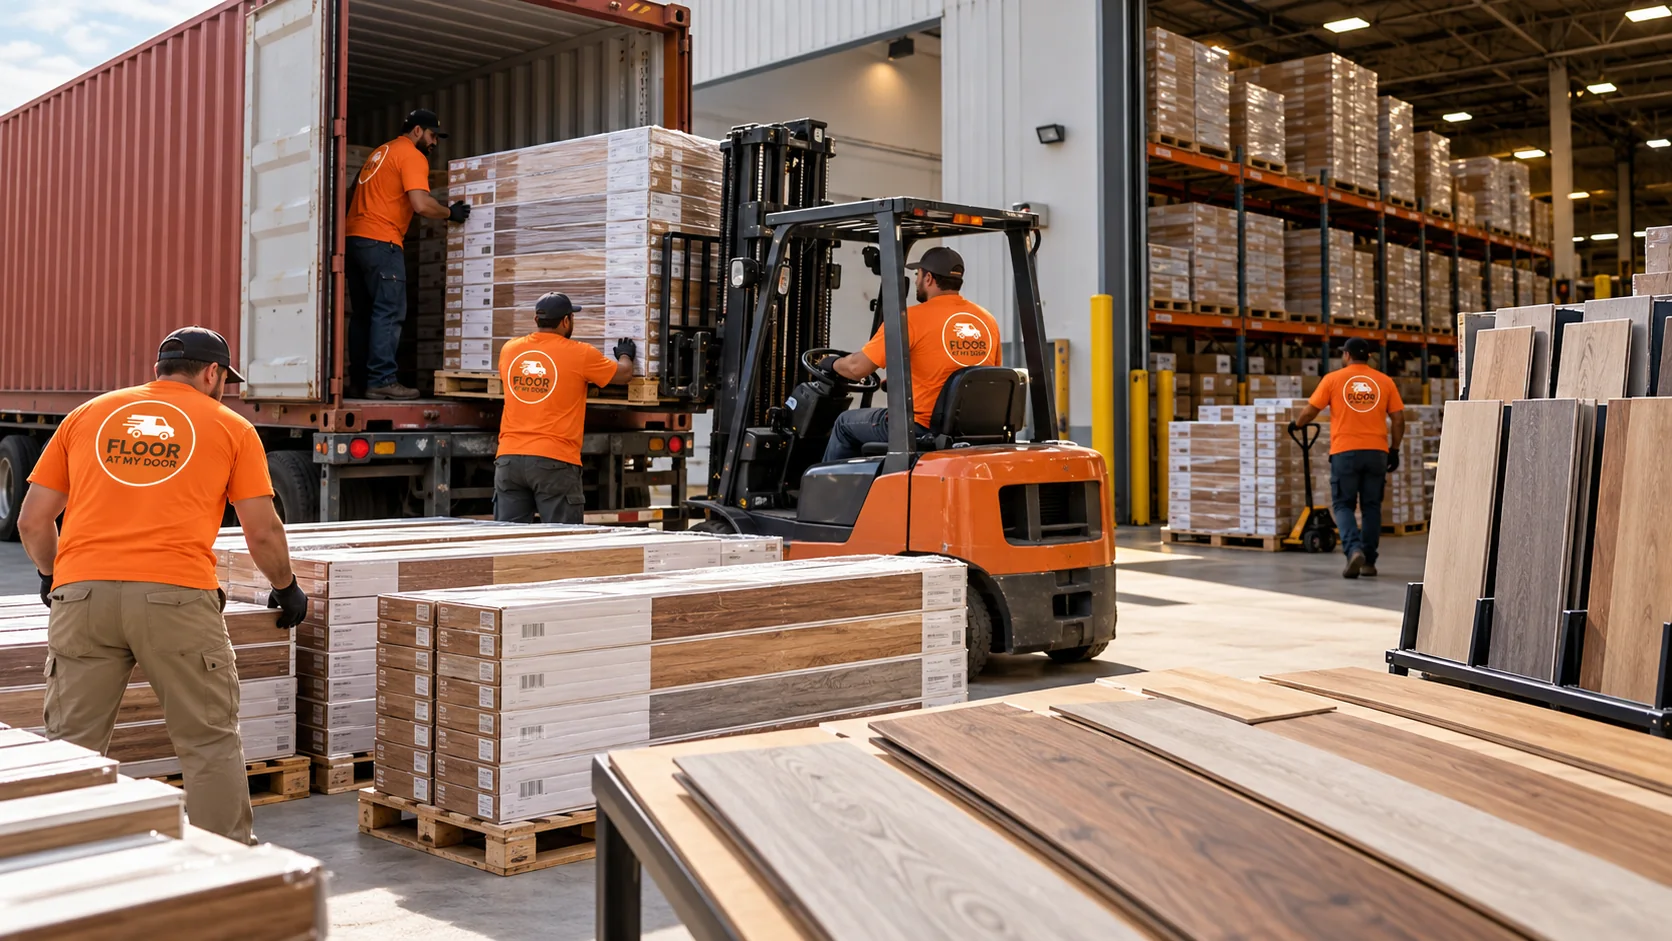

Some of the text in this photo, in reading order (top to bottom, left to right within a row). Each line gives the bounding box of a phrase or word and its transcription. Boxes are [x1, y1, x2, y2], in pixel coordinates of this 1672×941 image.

[513, 376, 550, 388] FLOOR
[107, 438, 181, 459] FLOOR
[105, 455, 177, 468] AT MY DOOR
